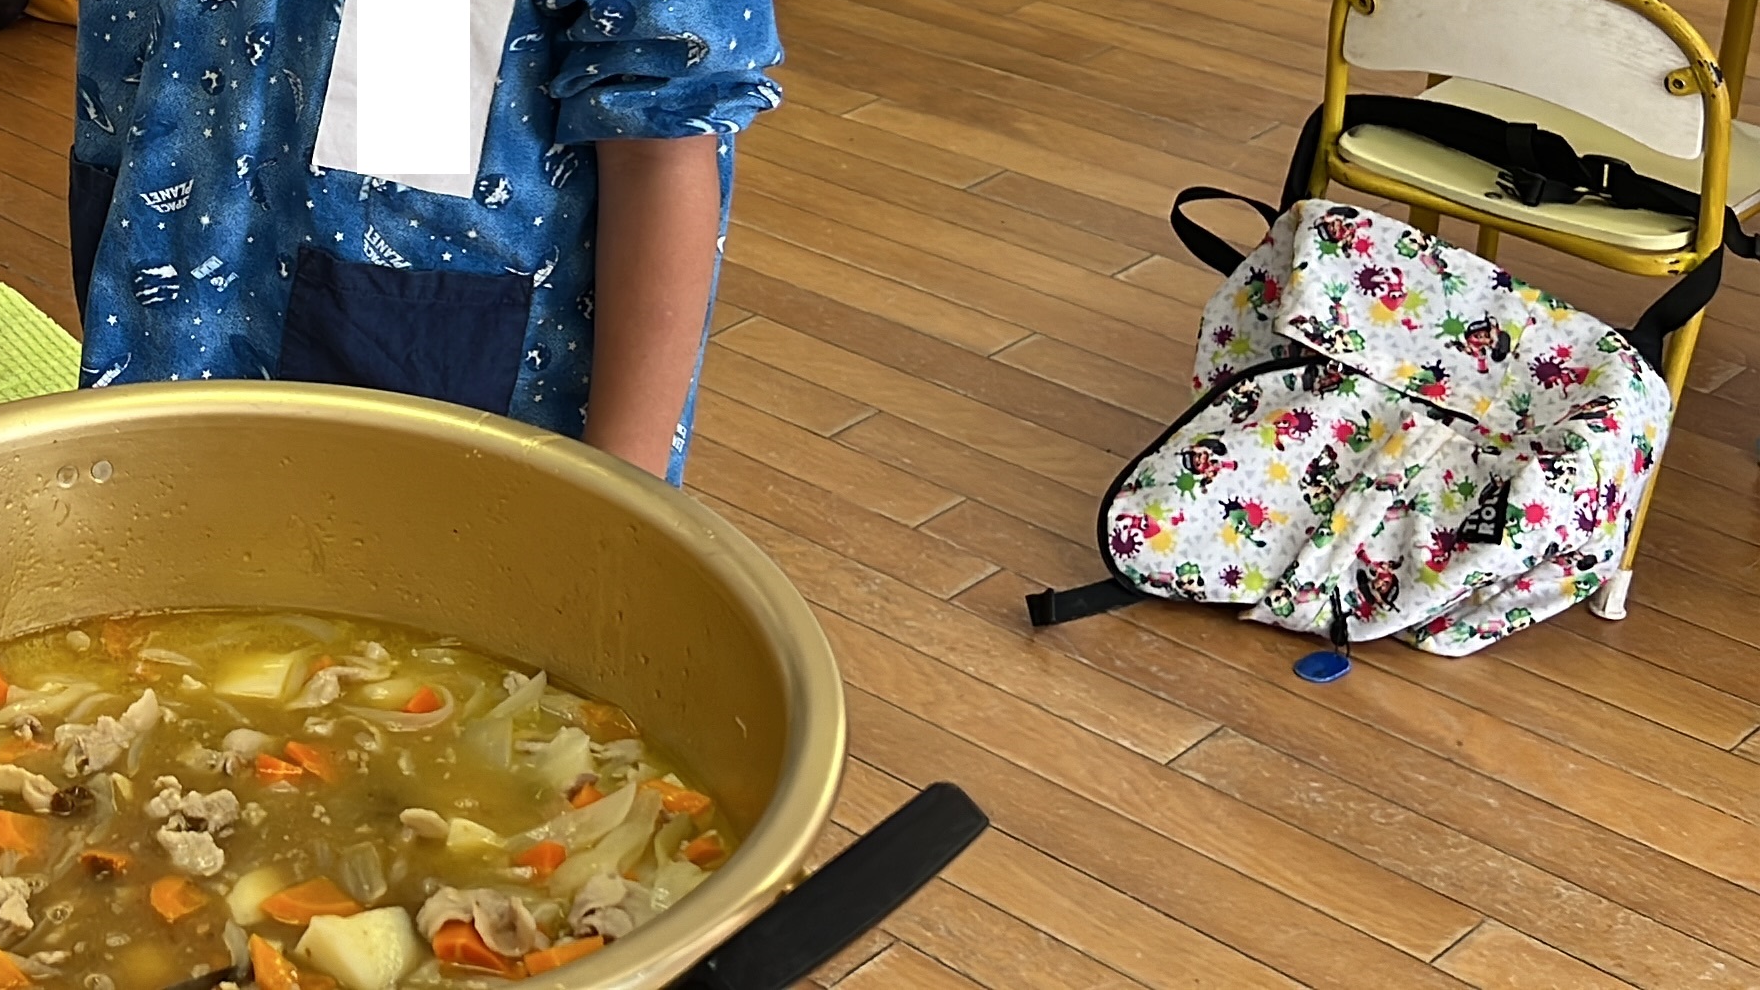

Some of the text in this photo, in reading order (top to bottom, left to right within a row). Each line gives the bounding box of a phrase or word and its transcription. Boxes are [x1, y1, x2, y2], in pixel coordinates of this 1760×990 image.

[140, 178, 195, 206] PLANET
[151, 195, 190, 213] SPACE
[364, 224, 412, 269] PLANET
